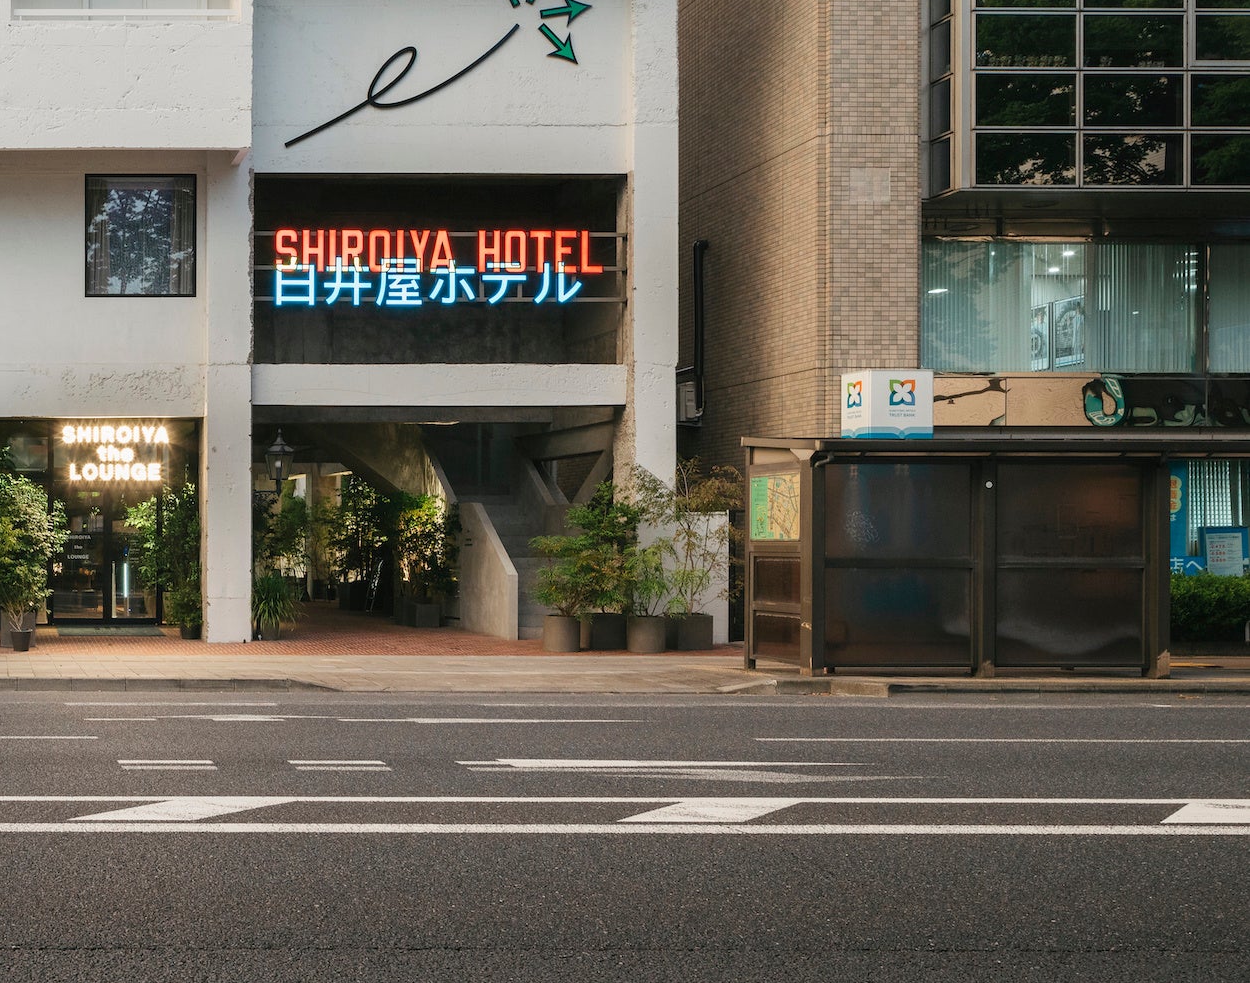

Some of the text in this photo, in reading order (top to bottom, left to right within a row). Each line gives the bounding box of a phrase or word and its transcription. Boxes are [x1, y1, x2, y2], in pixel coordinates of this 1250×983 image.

[274, 228, 604, 274] SHIROIYA HOTEL
[274, 256, 583, 307] 白井屋ホテル
[62, 425, 170, 444] SHIROIYA
[96, 444, 135, 462] the
[69, 462, 162, 481] LOUNGE
